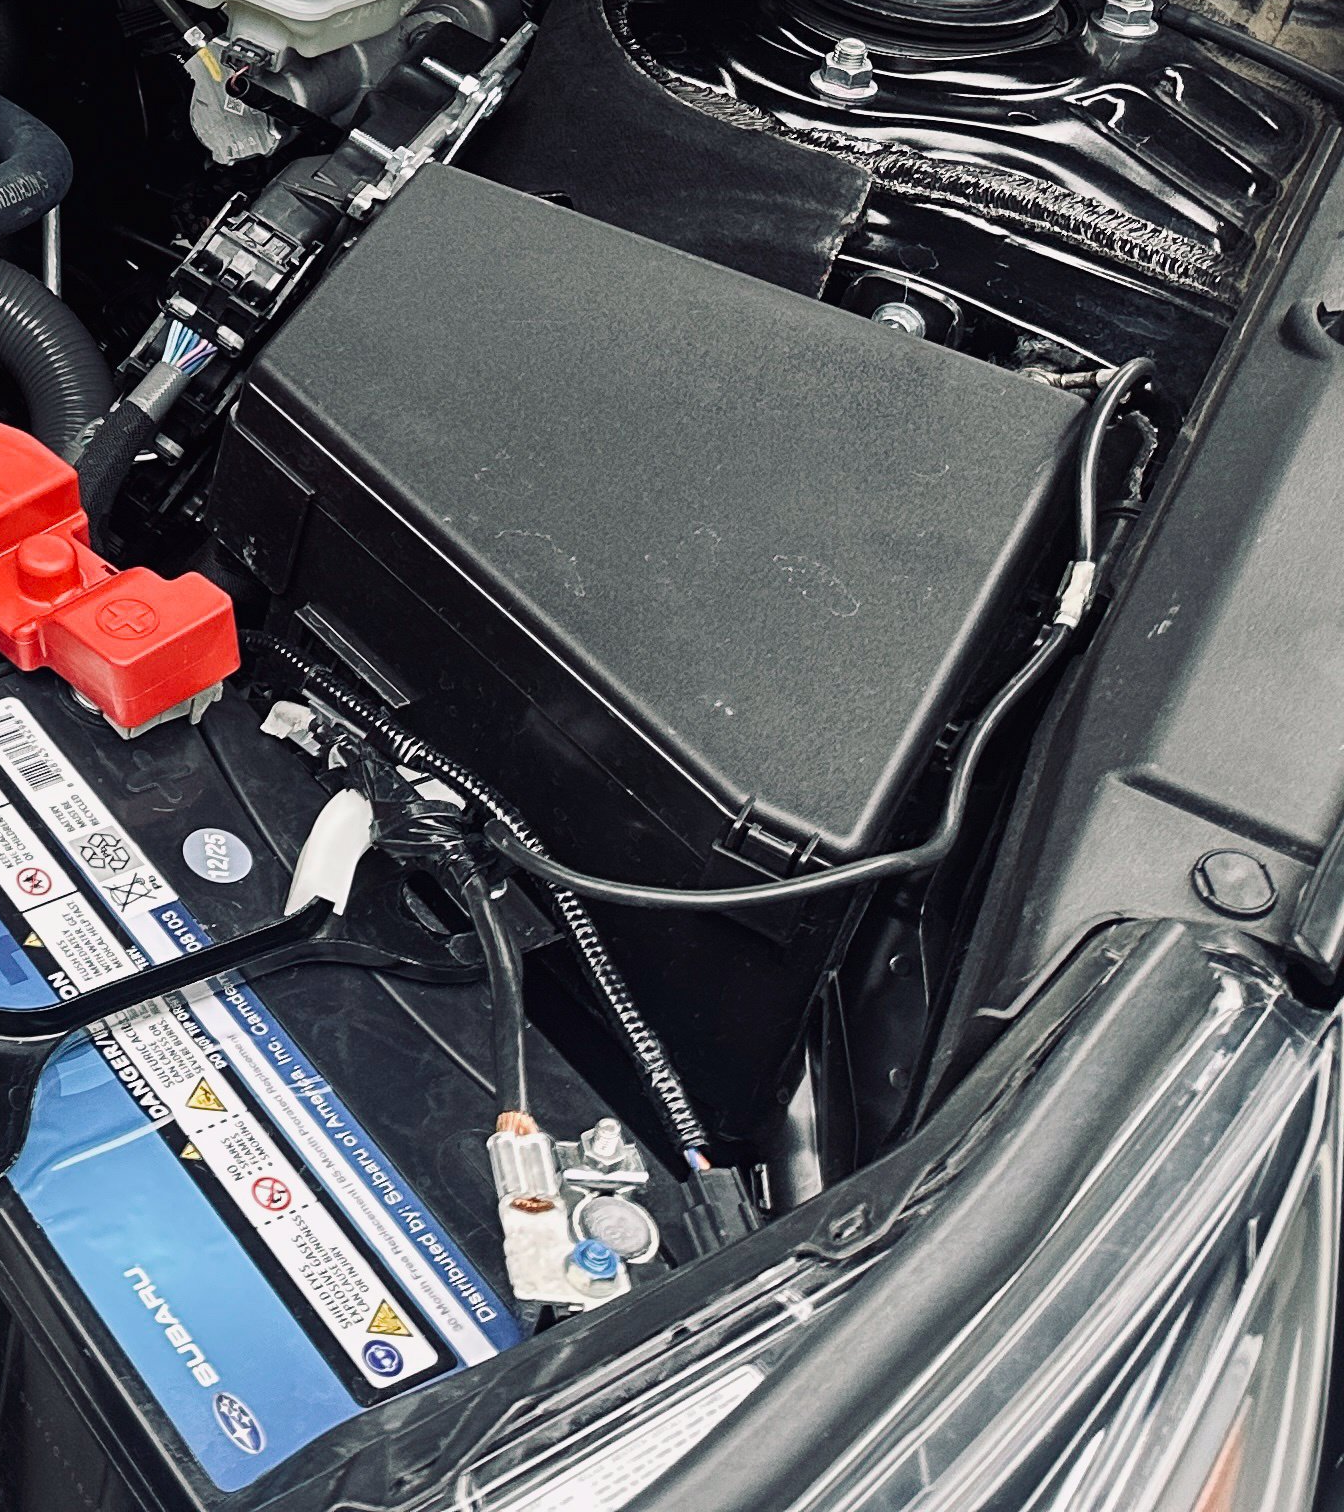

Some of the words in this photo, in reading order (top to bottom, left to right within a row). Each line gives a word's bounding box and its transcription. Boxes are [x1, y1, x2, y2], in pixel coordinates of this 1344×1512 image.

[49, 806, 76, 832] BATTERY
[61, 801, 72, 810] BE
[68, 810, 87, 828] MUST
[71, 794, 100, 826] RECYCLED
[10, 852, 24, 865] THE
[22, 852, 34, 861] OF
[204, 833, 229, 877] 12/25
[147, 875, 162, 890] Pb
[62, 913, 77, 926] GET
[80, 919, 98, 936] HELP
[161, 910, 203, 952] 08103
[57, 940, 75, 958] EYES
[62, 930, 103, 977] IMMEDIATELY
[94, 953, 113, 973] WITH
[96, 936, 123, 968] MEDICAL
[125, 945, 149, 971] TERY.
[71, 958, 93, 981] FLUSH
[224, 984, 269, 1036] Camde
[149, 1024, 161, 1036] OR
[183, 1021, 201, 1036] TIP
[148, 1041, 171, 1065] CAUSE
[158, 1037, 195, 1079] BLINDNESS
[194, 1036, 213, 1052] NOT
[266, 1036, 293, 1065] Inc.
[136, 1044, 175, 1088] SULFURIC
[168, 1066, 184, 1083] CAN
[179, 1047, 205, 1074] SEVERE
[209, 1054, 227, 1069] DO
[226, 1034, 277, 1094] Replacement
[273, 1094, 309, 1136] Prorated
[230, 1133, 259, 1165] FLAMES
[238, 1121, 268, 1160] SMOKING
[334, 1130, 358, 1146] of
[222, 1138, 249, 1169] SPARKS
[307, 1136, 346, 1183] 85-Month
[227, 1165, 244, 1181] NO
[352, 1148, 403, 1205] Subaru
[347, 1189, 402, 1255] Replacement
[293, 1215, 333, 1263] BLINDNESS
[293, 1235, 321, 1267] GASES
[329, 1247, 359, 1278] INJURY
[401, 1256, 422, 1280] Free
[329, 1264, 354, 1292] CAUSE
[354, 1279, 369, 1293] OR
[417, 1233, 497, 1323] Distributed
[318, 1269, 364, 1324] EXPLOSIVE
[319, 1292, 352, 1329] SHIELD
[351, 1293, 370, 1312] CAN
[420, 1281, 463, 1331] 30-Month
[122, 1263, 220, 1390] SUBARU
